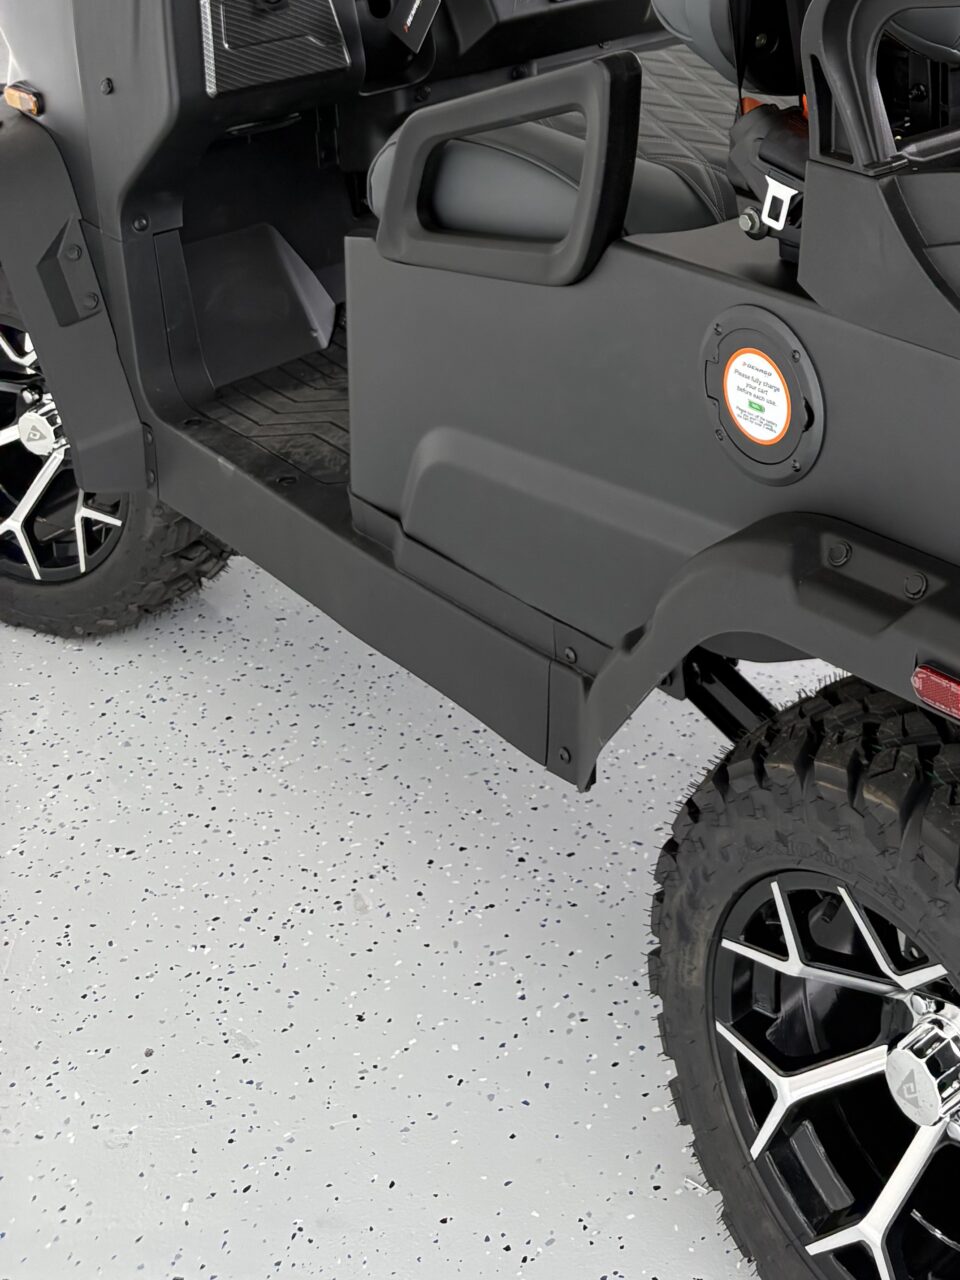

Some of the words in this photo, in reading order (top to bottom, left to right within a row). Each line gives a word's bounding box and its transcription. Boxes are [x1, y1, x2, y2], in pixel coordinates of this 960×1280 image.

[746, 364, 772, 376] DENAGO
[734, 369, 750, 380] Please
[751, 376, 762, 386] fully
[763, 382, 780, 392] charge
[736, 385, 752, 396] before
